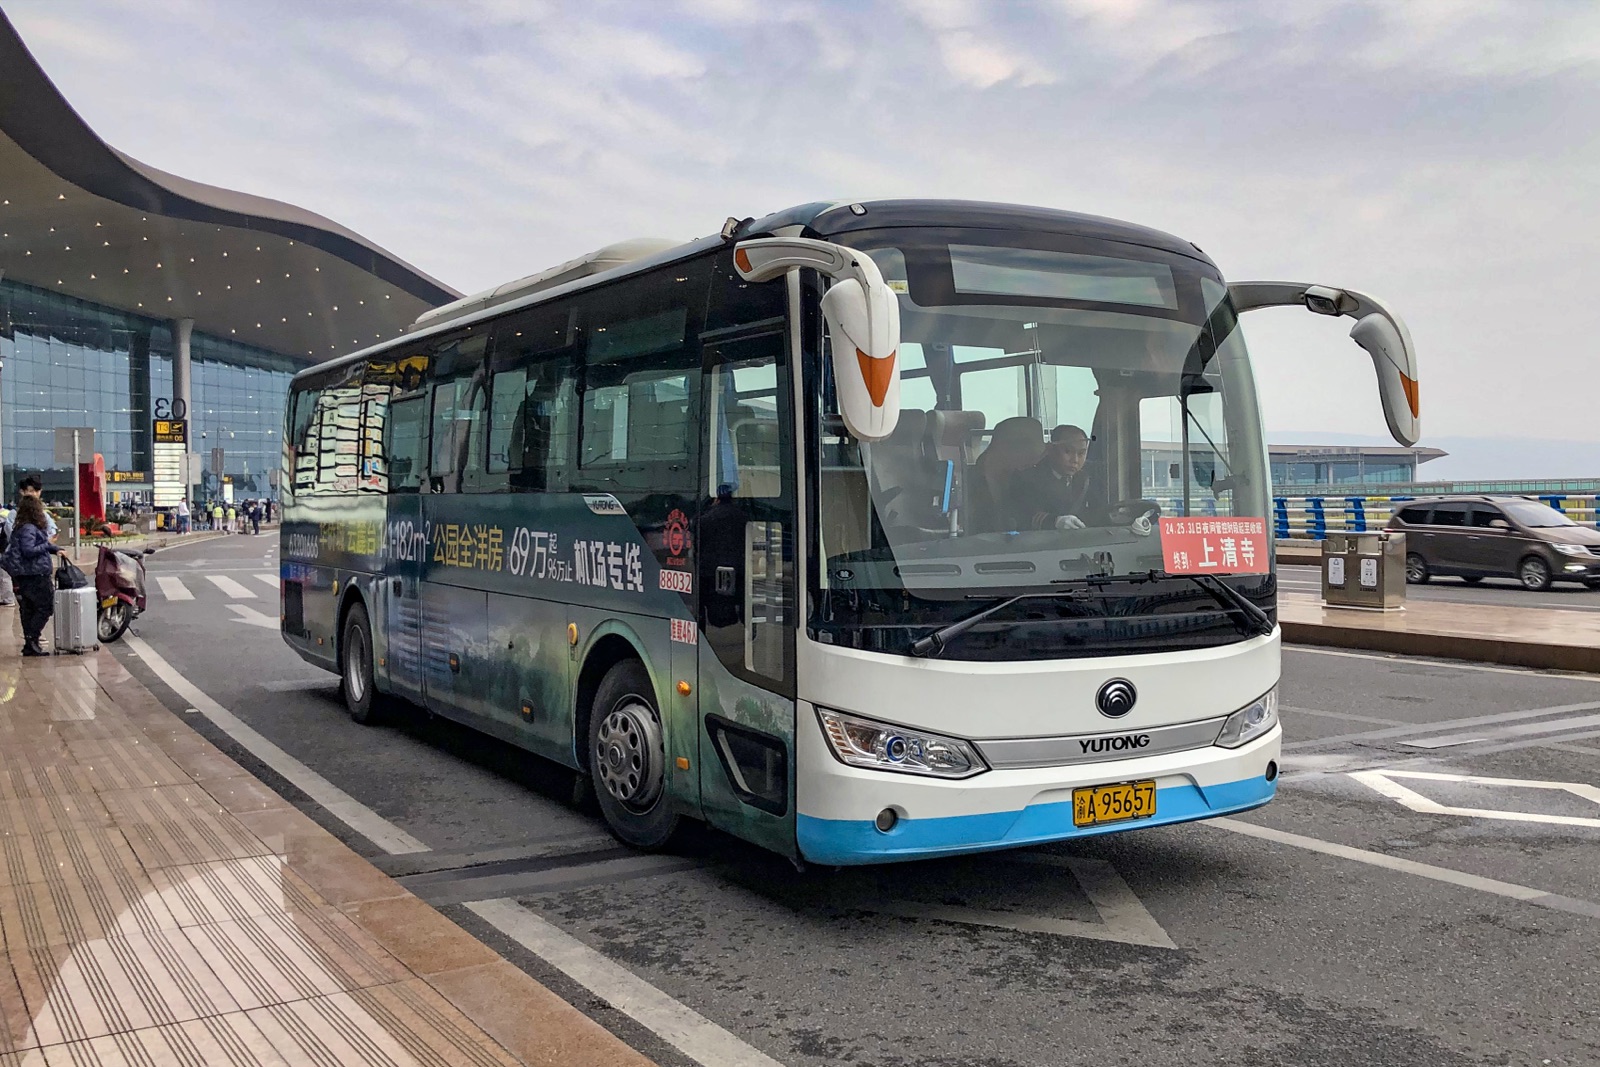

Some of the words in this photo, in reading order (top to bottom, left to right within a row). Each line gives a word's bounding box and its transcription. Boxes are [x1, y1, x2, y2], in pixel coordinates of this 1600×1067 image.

[158, 423, 169, 432] T3
[592, 500, 615, 510] YUTONG
[433, 523, 503, 572] 公园全洋房
[1198, 537, 1255, 568] 上清寺
[573, 539, 644, 593] 机场专线
[660, 570, 691, 592] 88032
[1079, 734, 1150, 753] YUTONG
